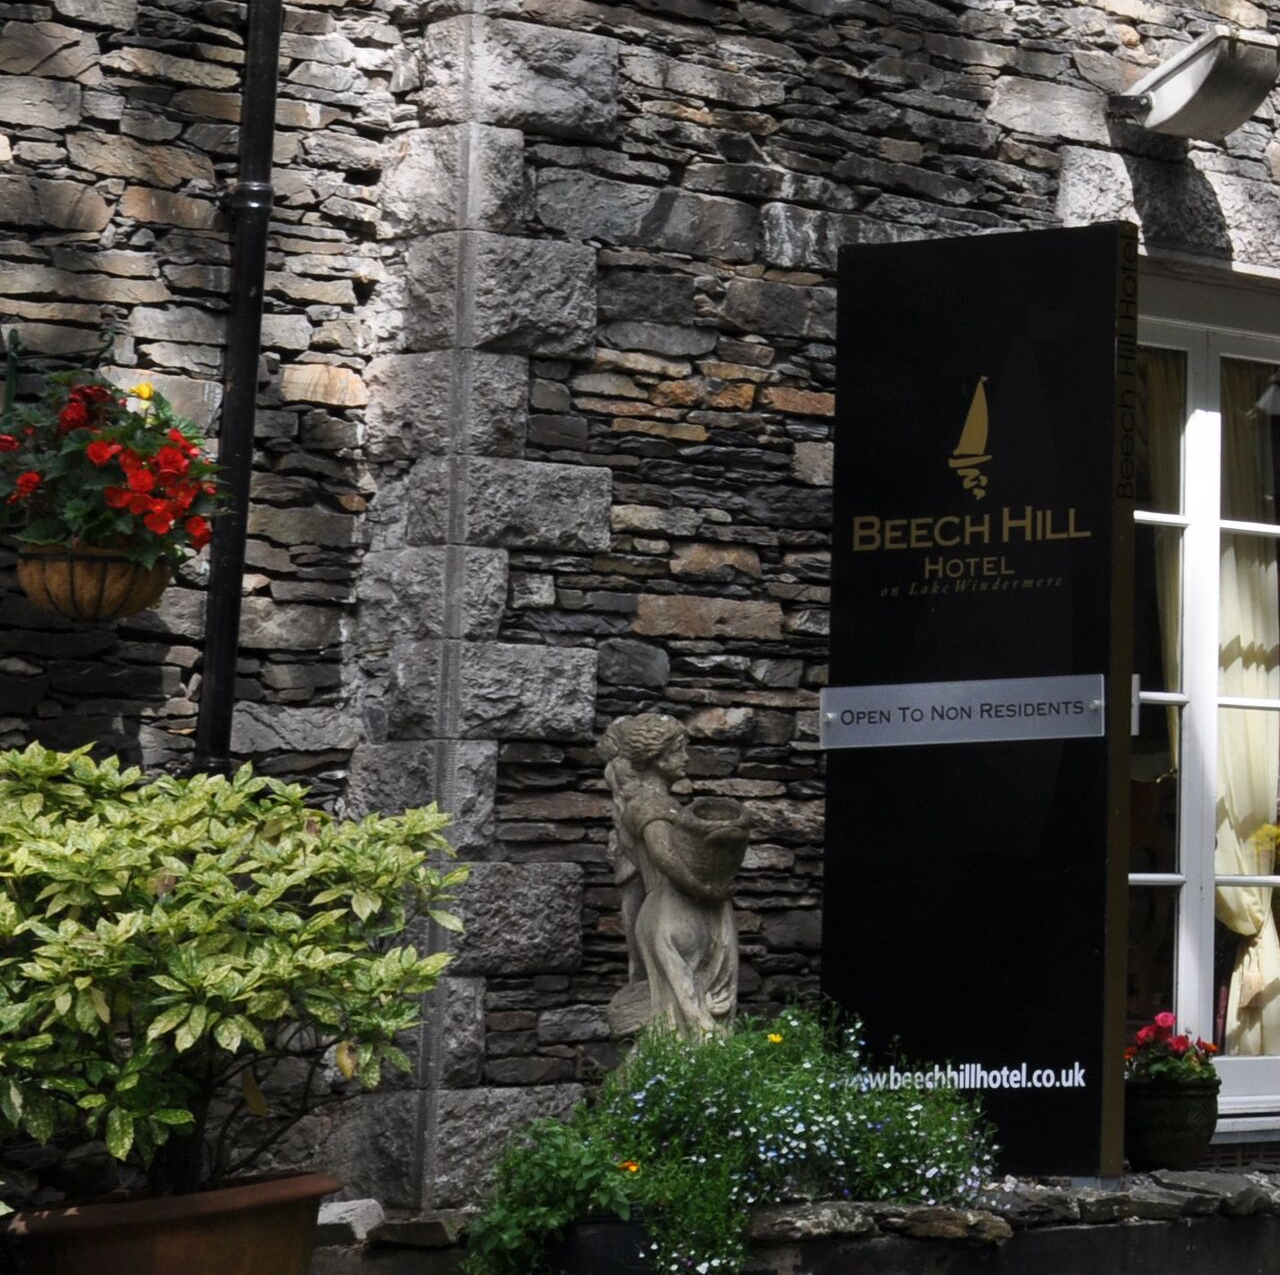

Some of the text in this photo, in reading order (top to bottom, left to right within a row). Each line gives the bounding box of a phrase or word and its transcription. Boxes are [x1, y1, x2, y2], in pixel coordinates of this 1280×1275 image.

[1116, 233, 1139, 500] Beech Hill Hotel
[852, 505, 1092, 552] BEECH HILL
[924, 555, 1016, 580] HOTEL
[908, 581, 951, 597] Lake
[954, 575, 1065, 594] Windermere
[840, 700, 1085, 726] OPEN TO NON RESIDENTS
[842, 1061, 1086, 1091] w.beechhillhotel.co.uk
